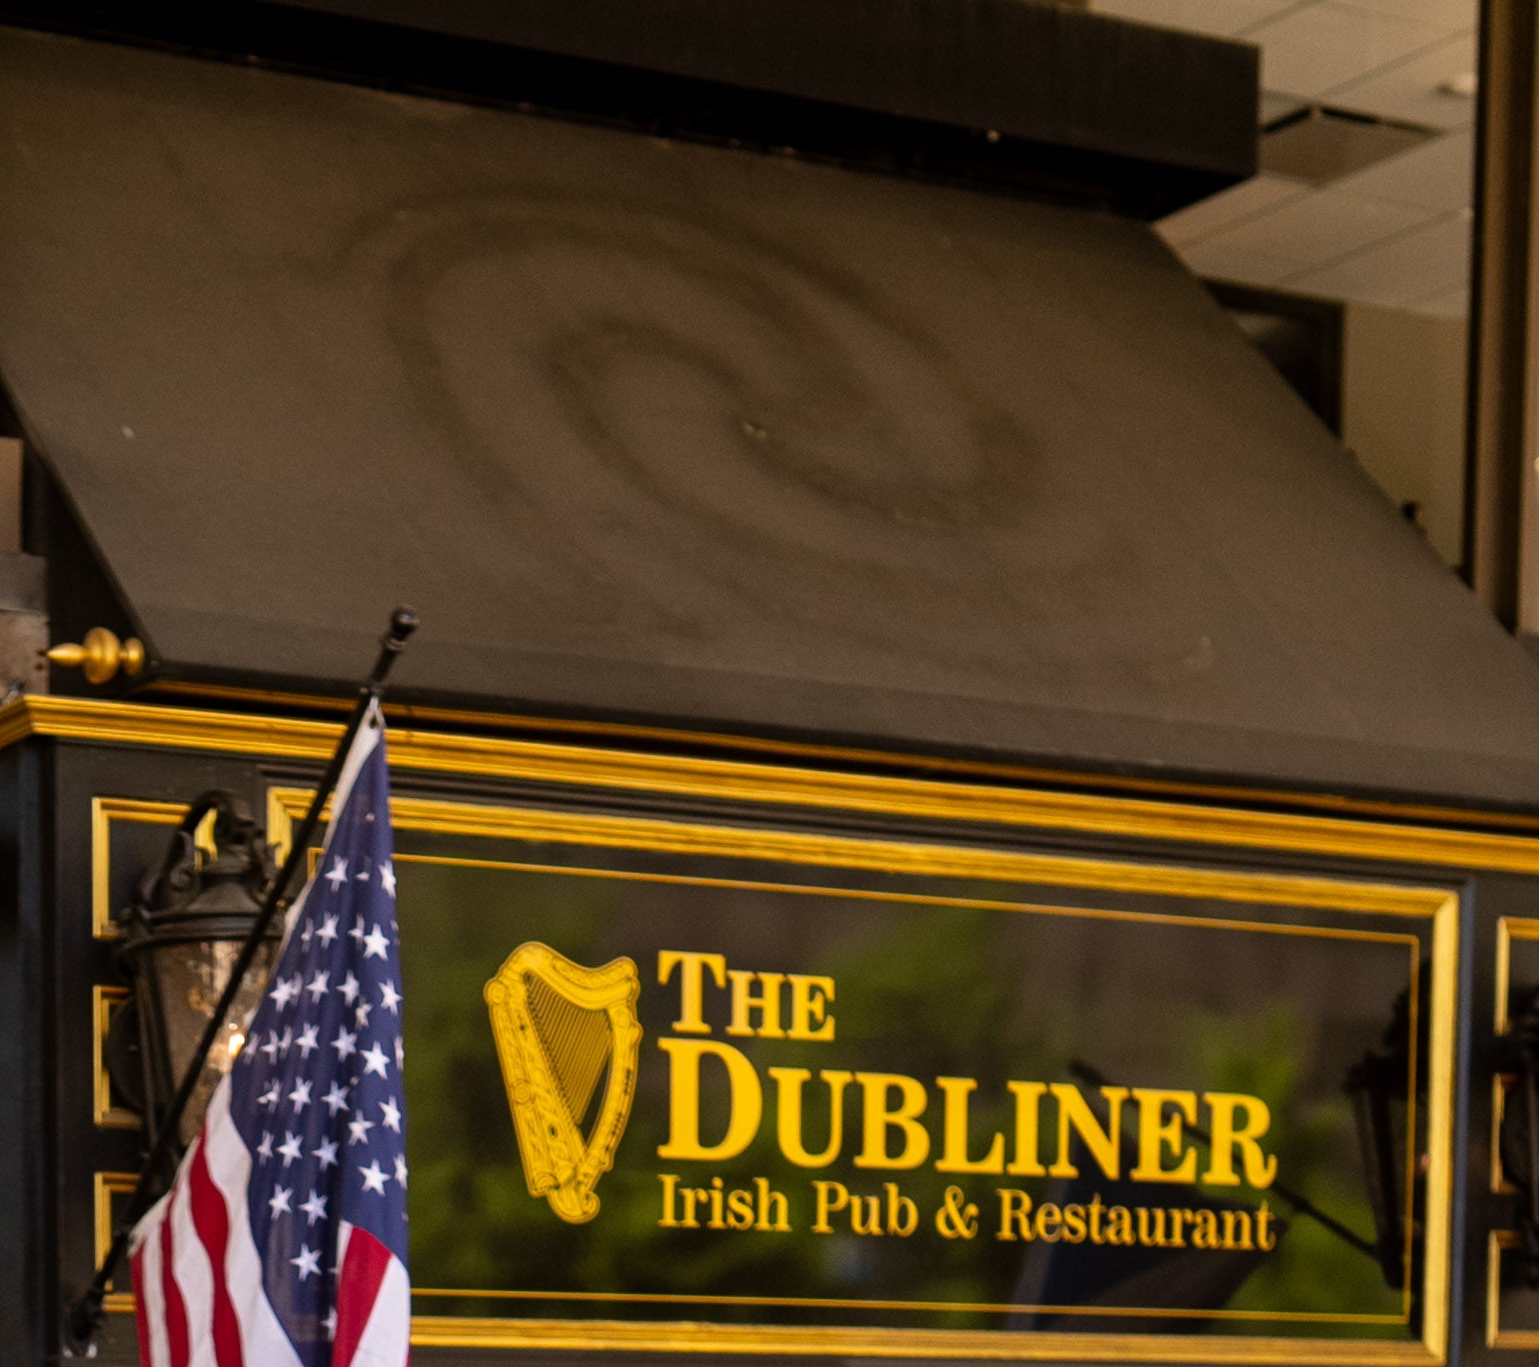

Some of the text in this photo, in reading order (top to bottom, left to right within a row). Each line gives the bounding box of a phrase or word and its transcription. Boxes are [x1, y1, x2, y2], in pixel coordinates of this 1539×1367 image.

[657, 949, 835, 1041] THE
[657, 1037, 1277, 1188] DUBLINER
[657, 1174, 1276, 1251] Irish Pub & Restaurant
